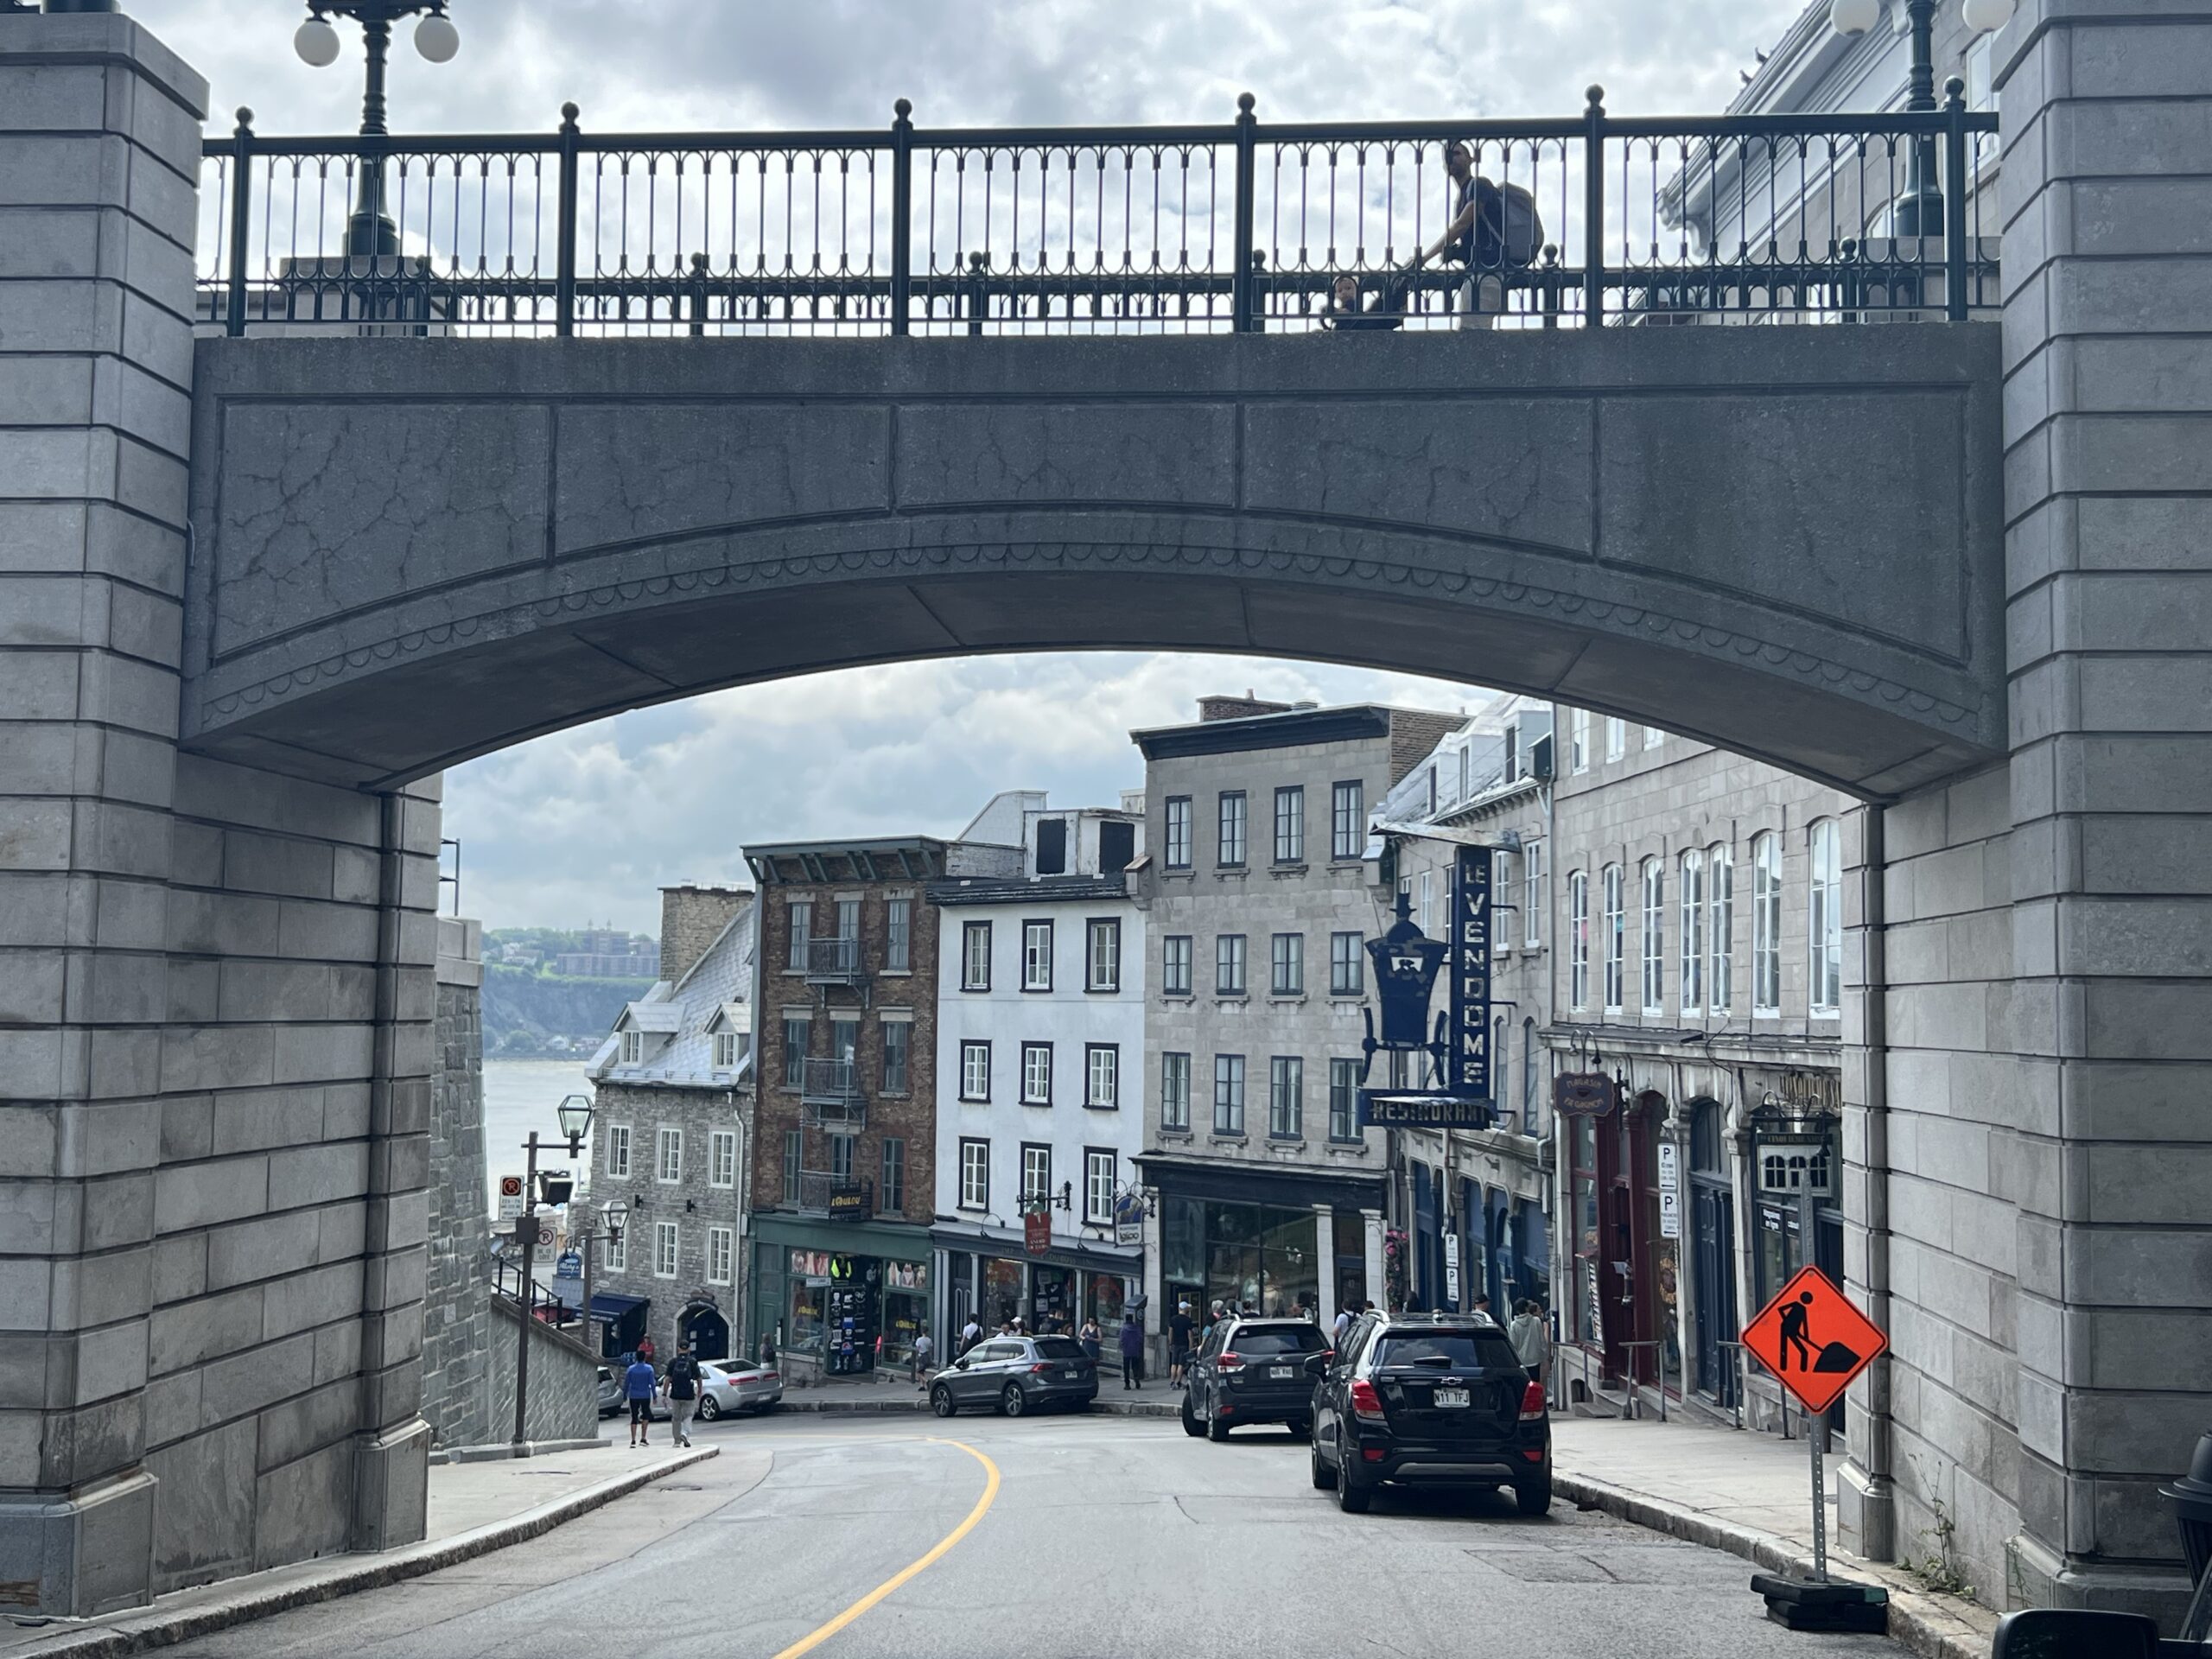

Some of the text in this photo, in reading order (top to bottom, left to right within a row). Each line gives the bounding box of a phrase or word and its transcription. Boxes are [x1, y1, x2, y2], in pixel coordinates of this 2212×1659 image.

[1463, 864, 1486, 1084] LE VENDOME
[1663, 1147, 1670, 1160] P
[831, 1196, 861, 1206] LOULOU
[1665, 1196, 1673, 1211] P
[1449, 1271, 1455, 1281] P
[1434, 1393, 1469, 1402] N11 TFJ
